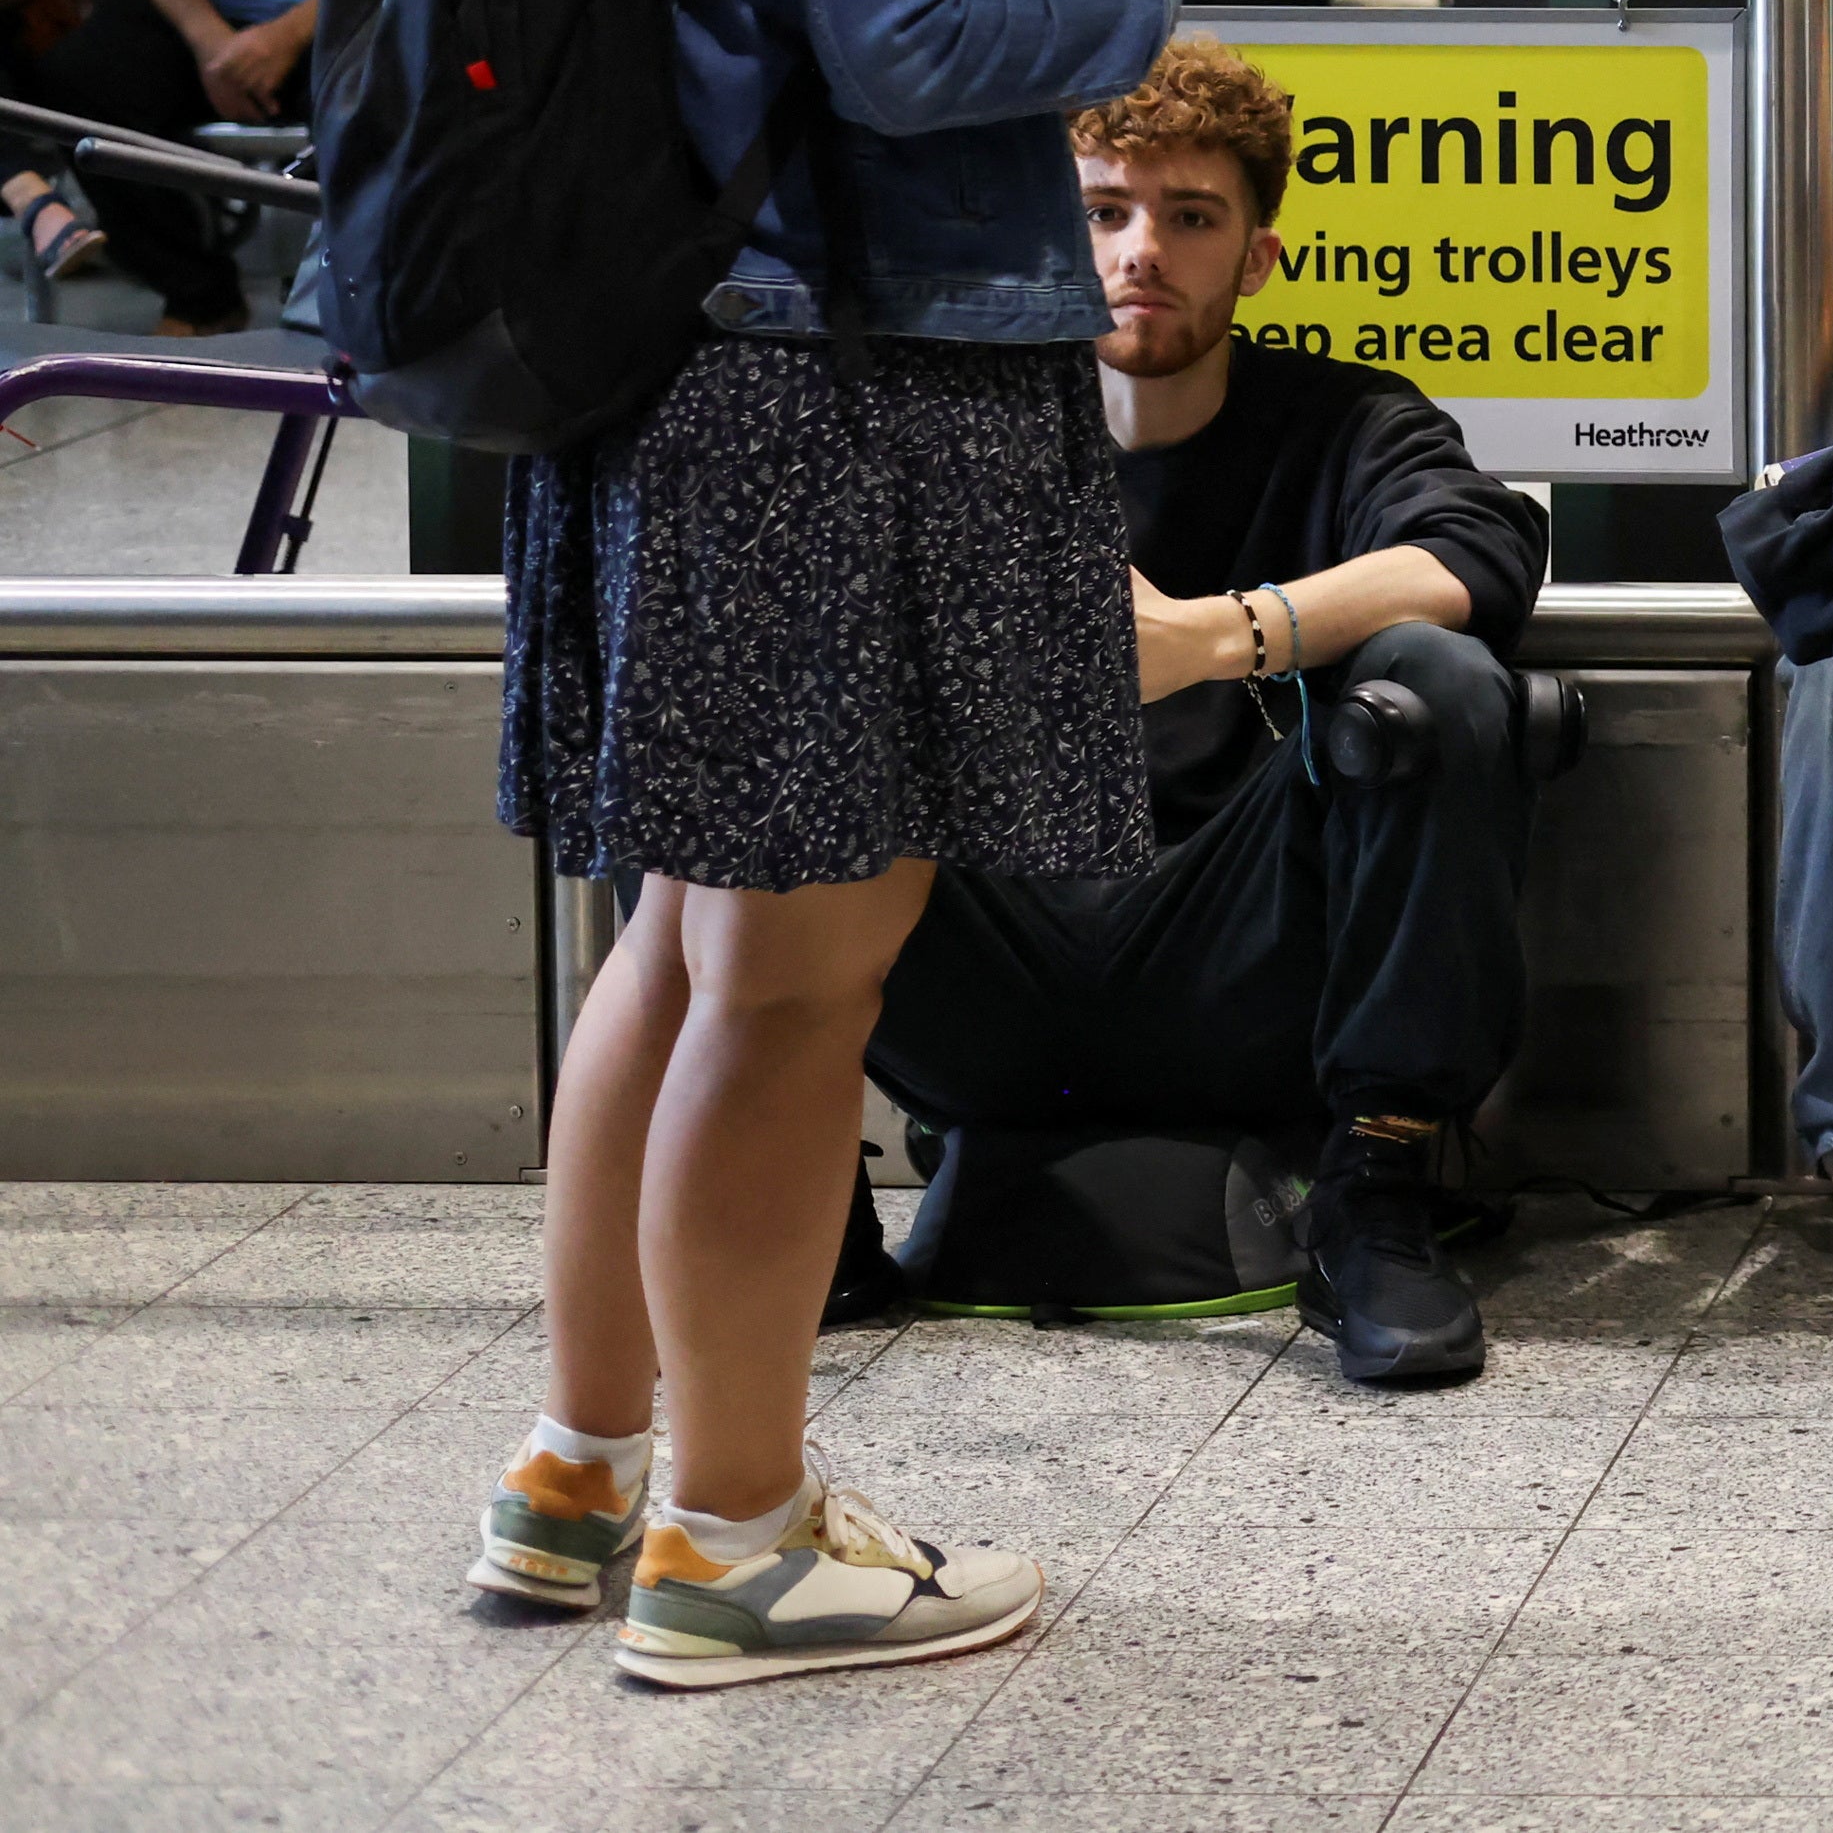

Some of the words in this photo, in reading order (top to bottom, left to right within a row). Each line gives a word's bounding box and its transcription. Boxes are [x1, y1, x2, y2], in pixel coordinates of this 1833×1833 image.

[1288, 90, 1673, 212] arning
[1278, 230, 1410, 297] ving
[1433, 230, 1673, 299] trolleys
[1356, 320, 1490, 363] area
[1513, 309, 1665, 364] clear
[1574, 421, 1710, 448] Heathrow
